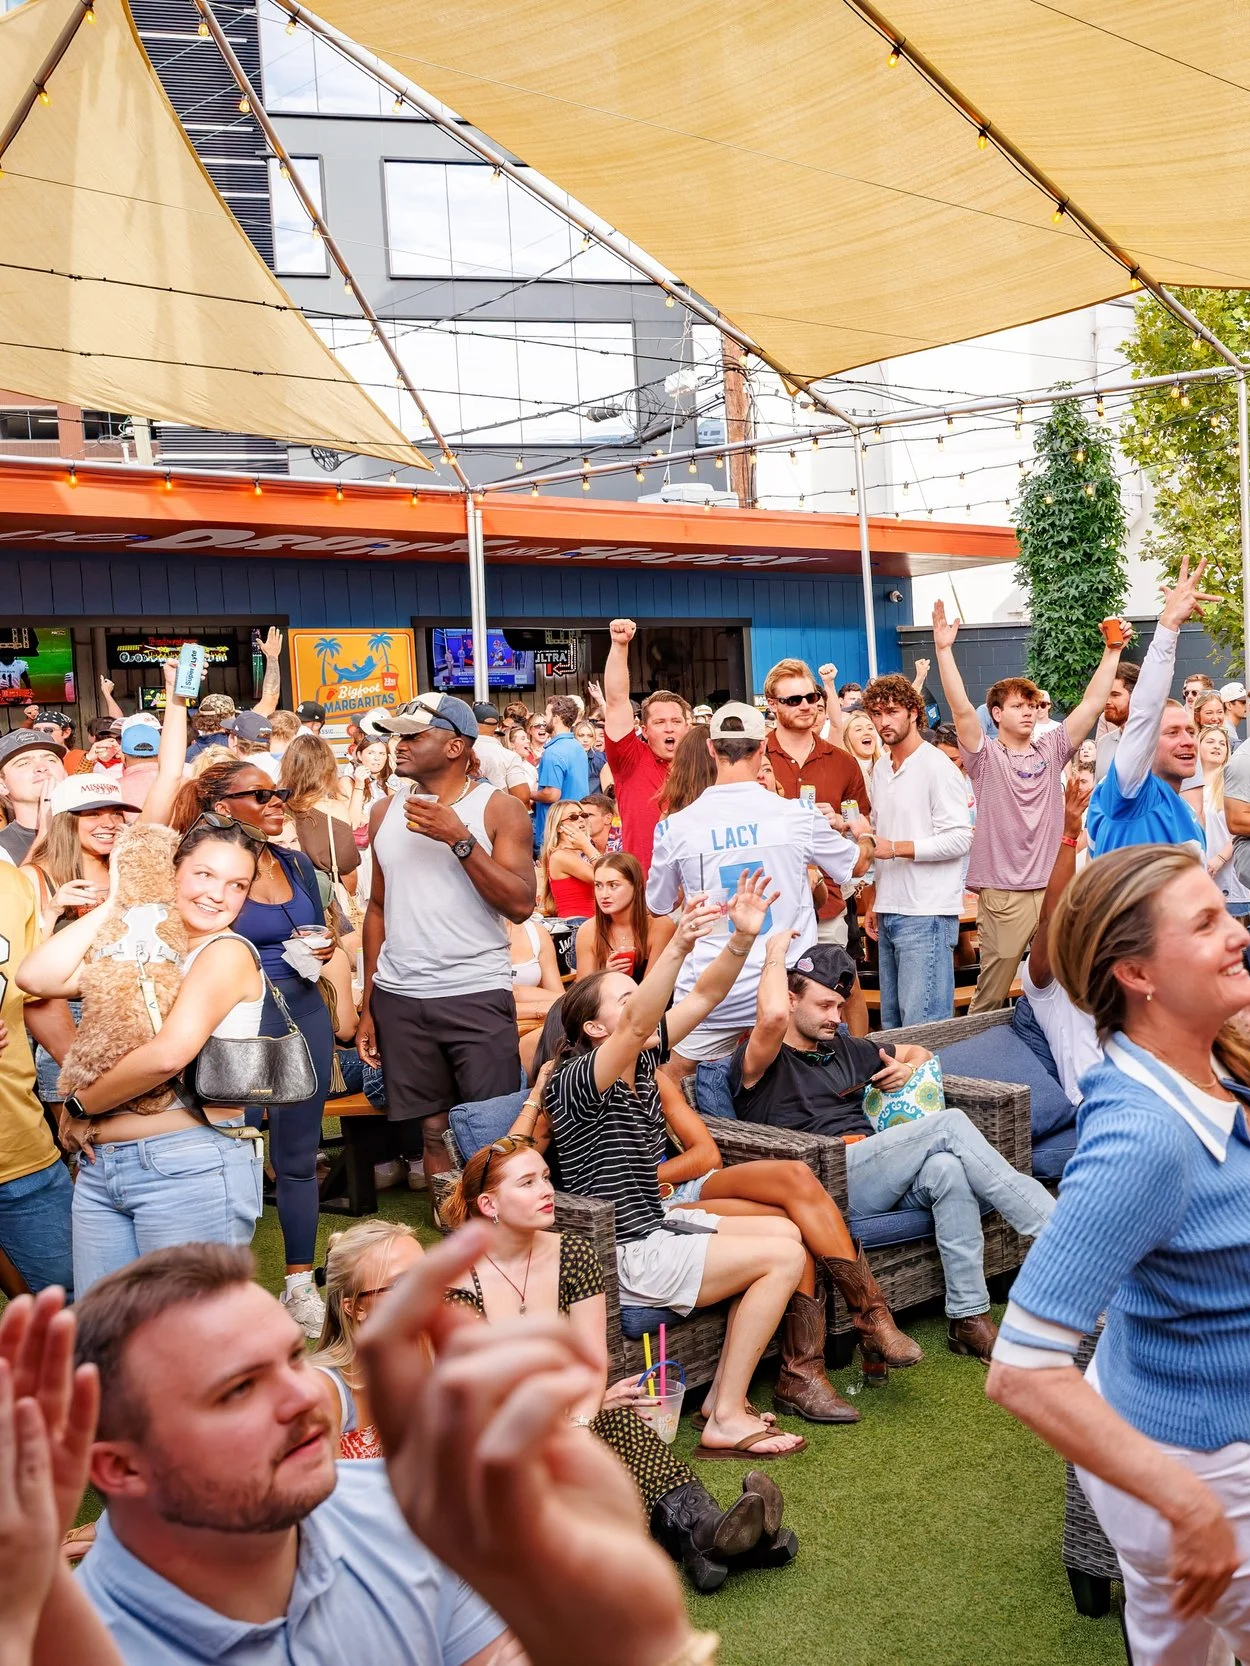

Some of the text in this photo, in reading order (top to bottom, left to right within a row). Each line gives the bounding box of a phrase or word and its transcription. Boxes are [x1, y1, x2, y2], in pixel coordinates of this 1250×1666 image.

[484, 546, 560, 557] AND
[190, 650, 198, 663] Lyte
[185, 668, 195, 686] Super
[338, 683, 381, 699] Bigfoot
[323, 693, 395, 713] MARGARITAS
[711, 823, 758, 851] LACY
